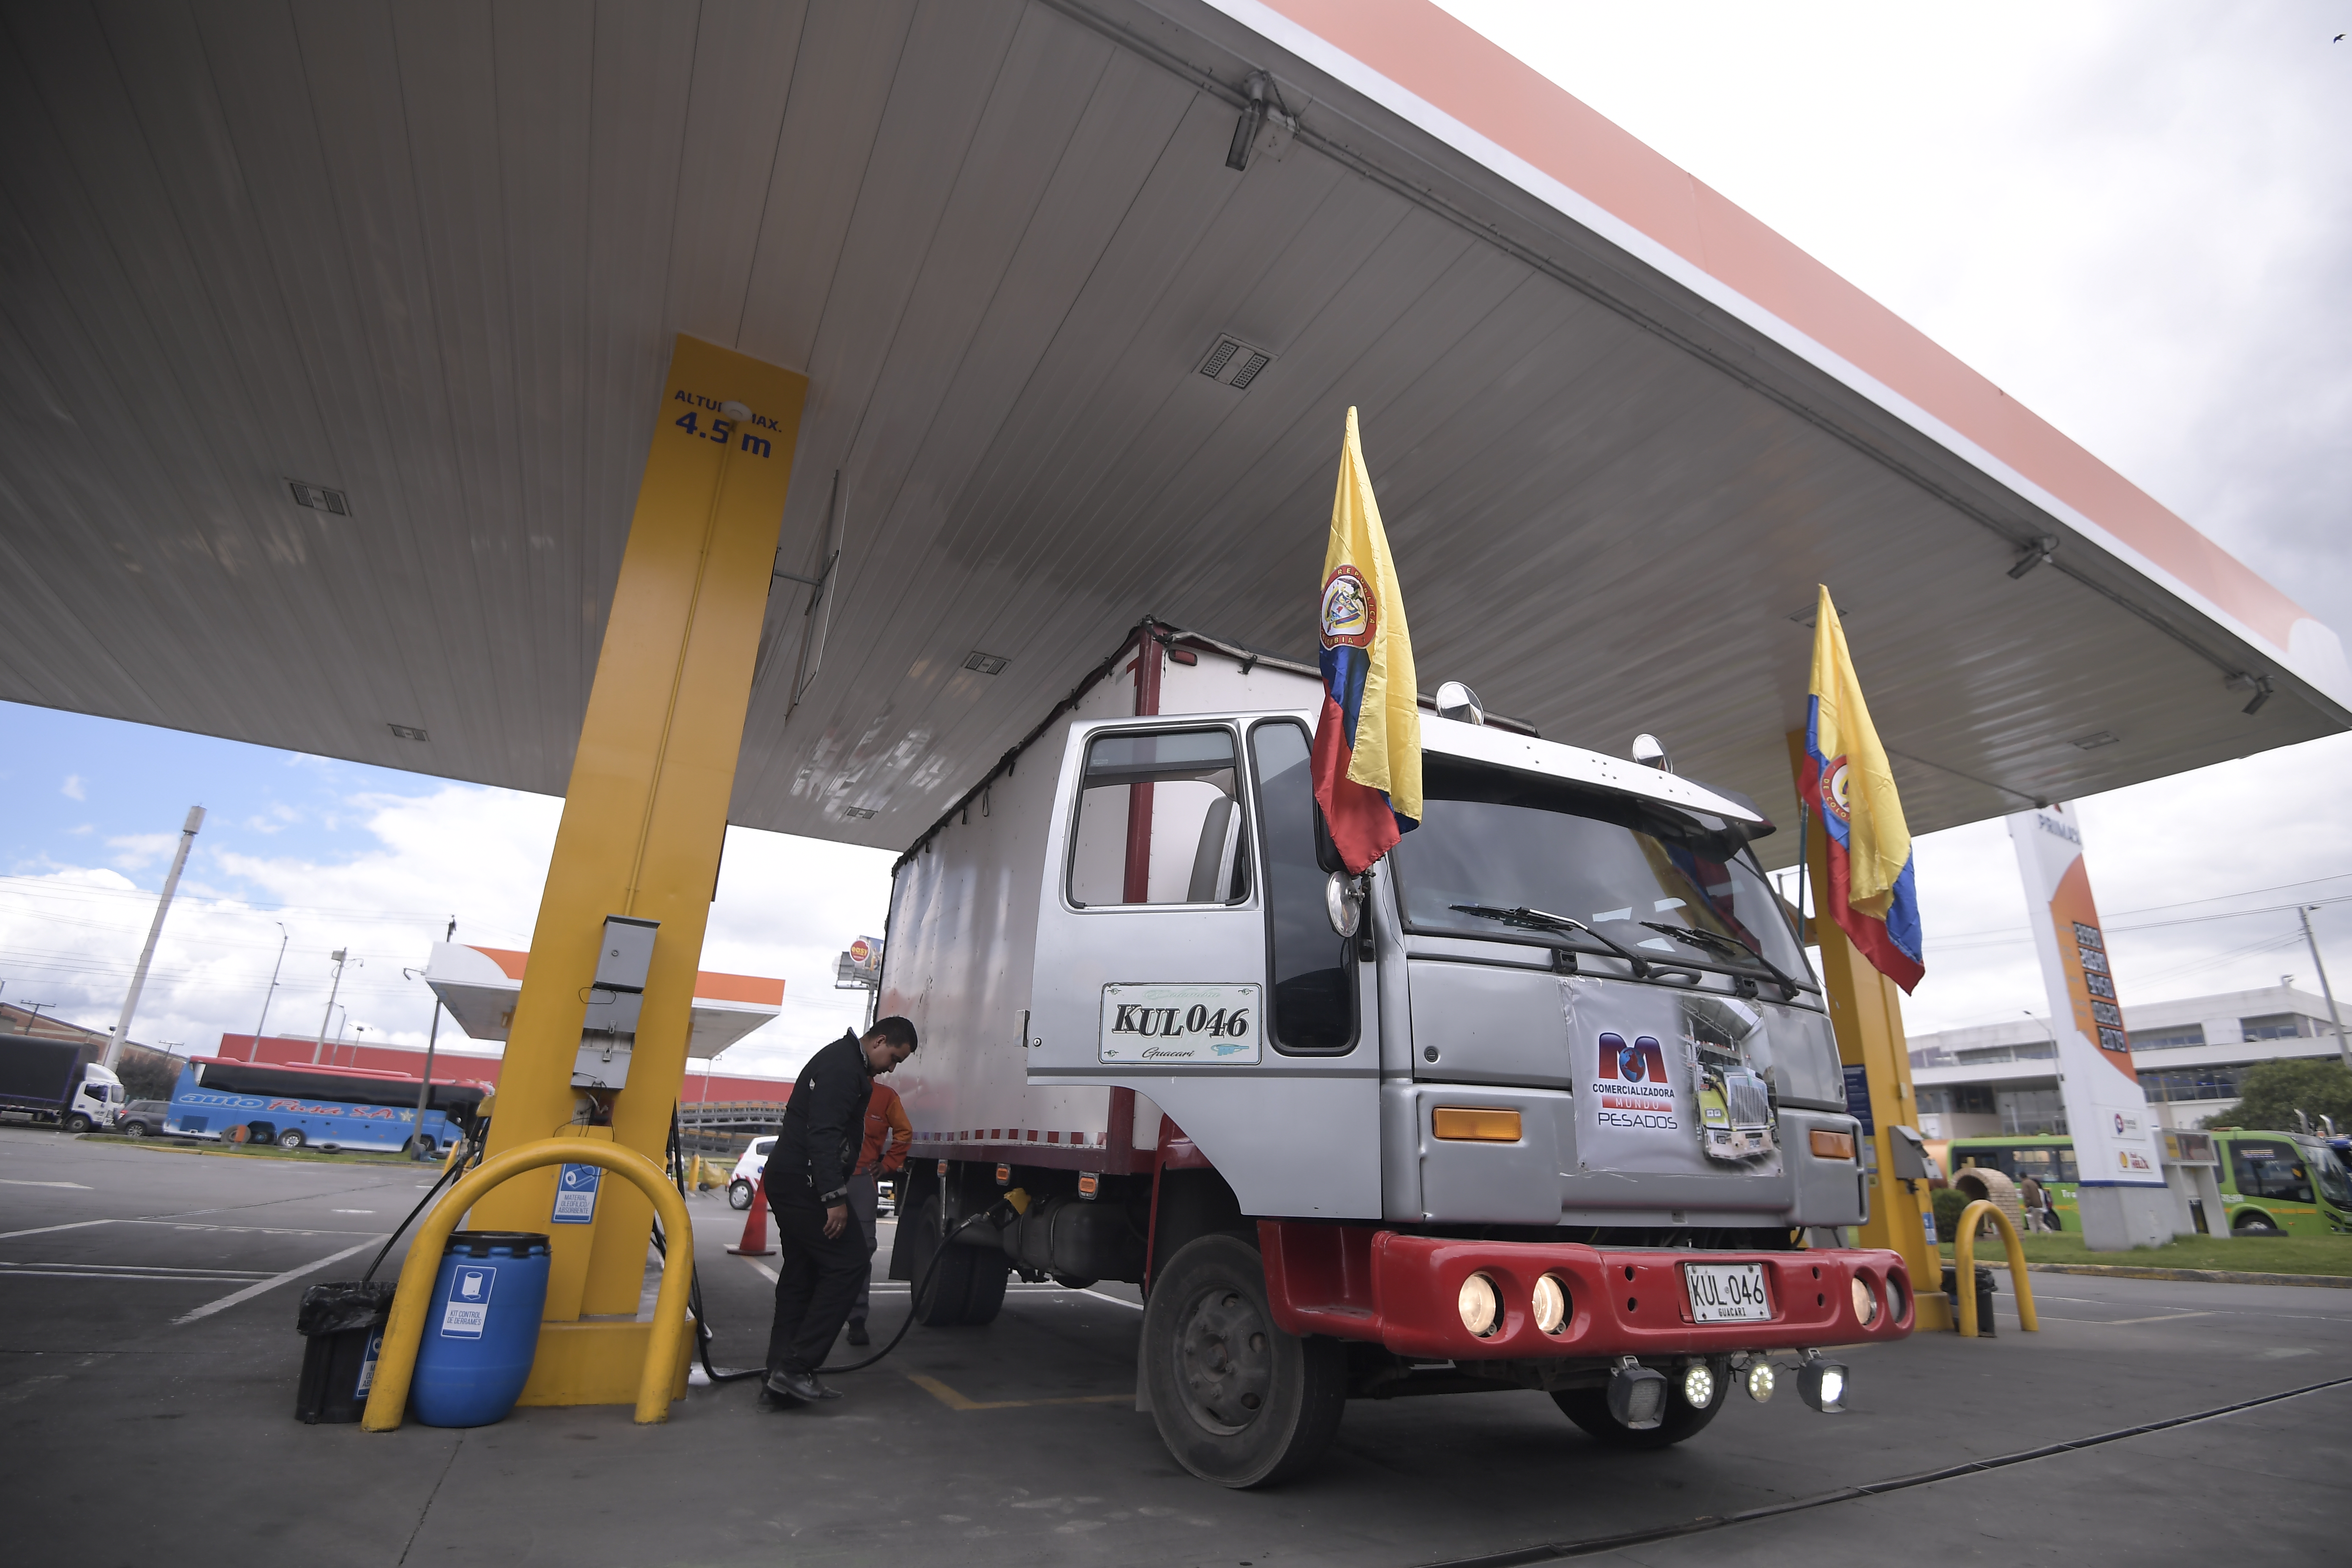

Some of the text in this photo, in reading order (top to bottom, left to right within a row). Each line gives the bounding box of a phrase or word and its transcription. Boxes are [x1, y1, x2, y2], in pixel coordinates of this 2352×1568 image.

[676, 411, 771, 458] 4.5 m
[1321, 629, 1353, 645] OLOMBIA
[1823, 778, 1830, 789] DE
[852, 946, 868, 956] easy
[1142, 1047, 1195, 1059] Guacari
[1592, 1083, 1675, 1098] COMERCIALIZADORA
[1615, 1098, 1659, 1110] MUNDO
[1598, 1112, 1678, 1130] PESADOS
[459, 1310, 481, 1318] CONTROL
[1718, 1307, 1746, 1317] GUACARI
[454, 1318, 482, 1326] DERRAMES
